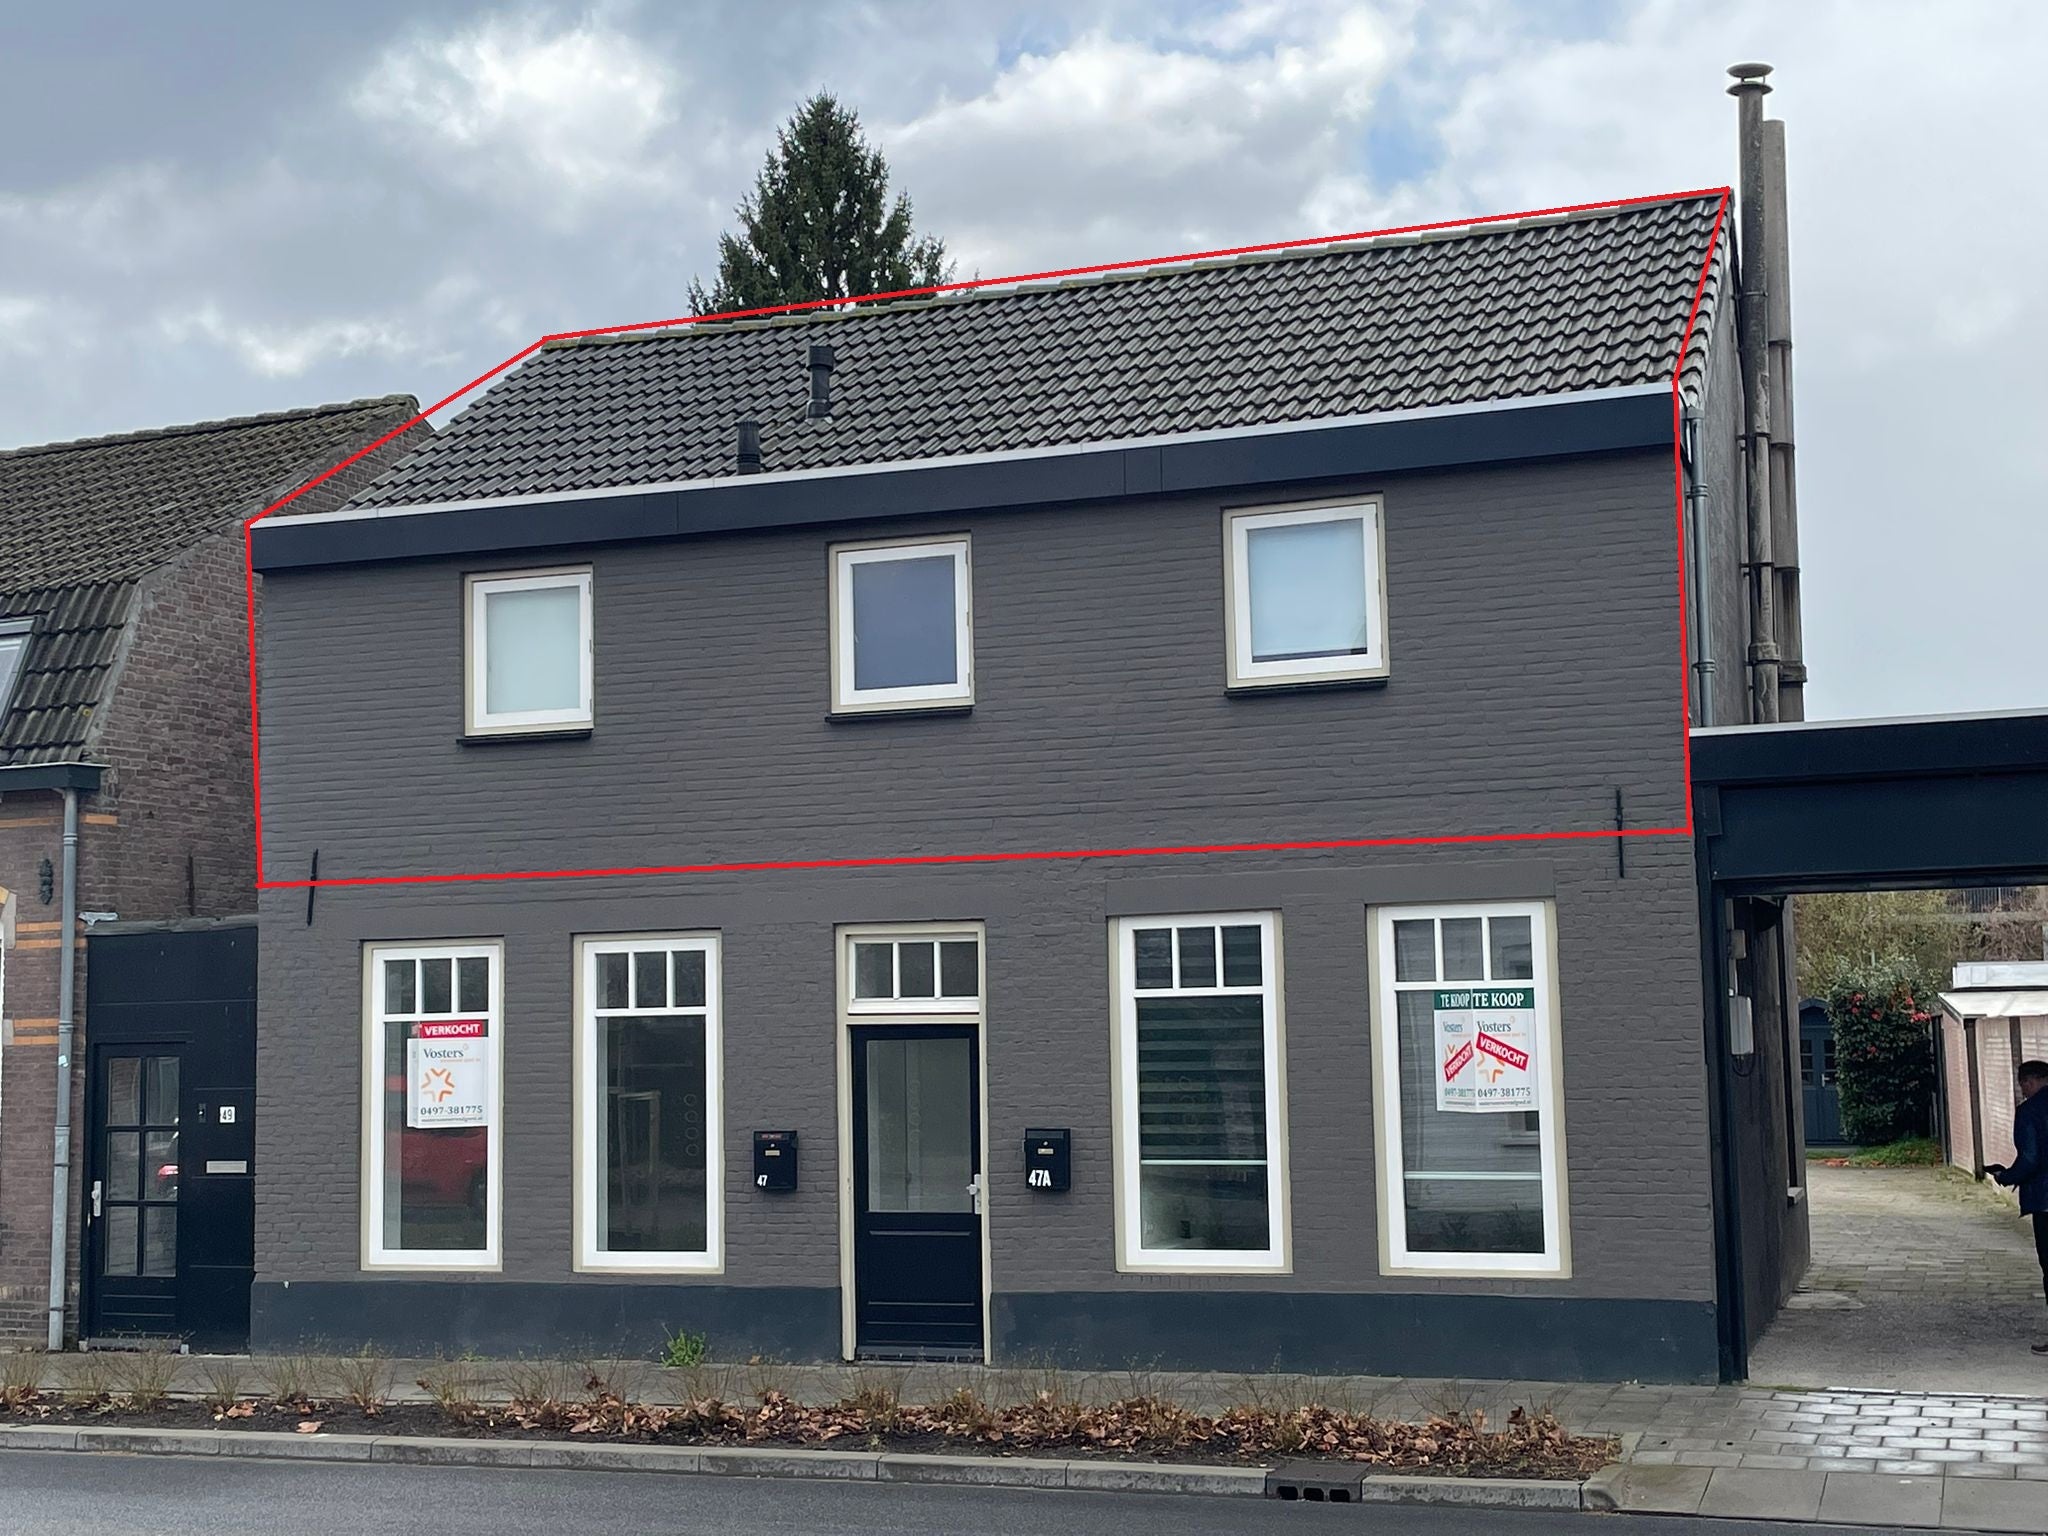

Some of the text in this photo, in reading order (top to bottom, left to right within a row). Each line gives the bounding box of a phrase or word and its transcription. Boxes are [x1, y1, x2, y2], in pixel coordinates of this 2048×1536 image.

[1440, 993, 1470, 1008] TE KOOP
[1473, 992, 1525, 1007] TE KOOP
[424, 1023, 480, 1037] VERKOCHT
[1477, 1020, 1512, 1033] Vosters
[424, 1048, 464, 1059] Vosters
[1480, 1036, 1526, 1067] VERKOCHT
[1477, 1087, 1531, 1098] 0497-381775
[222, 1108, 233, 1121] 49
[421, 1105, 483, 1116] 0497-381775
[757, 1174, 768, 1187] 47
[1028, 1169, 1052, 1187] 47A
